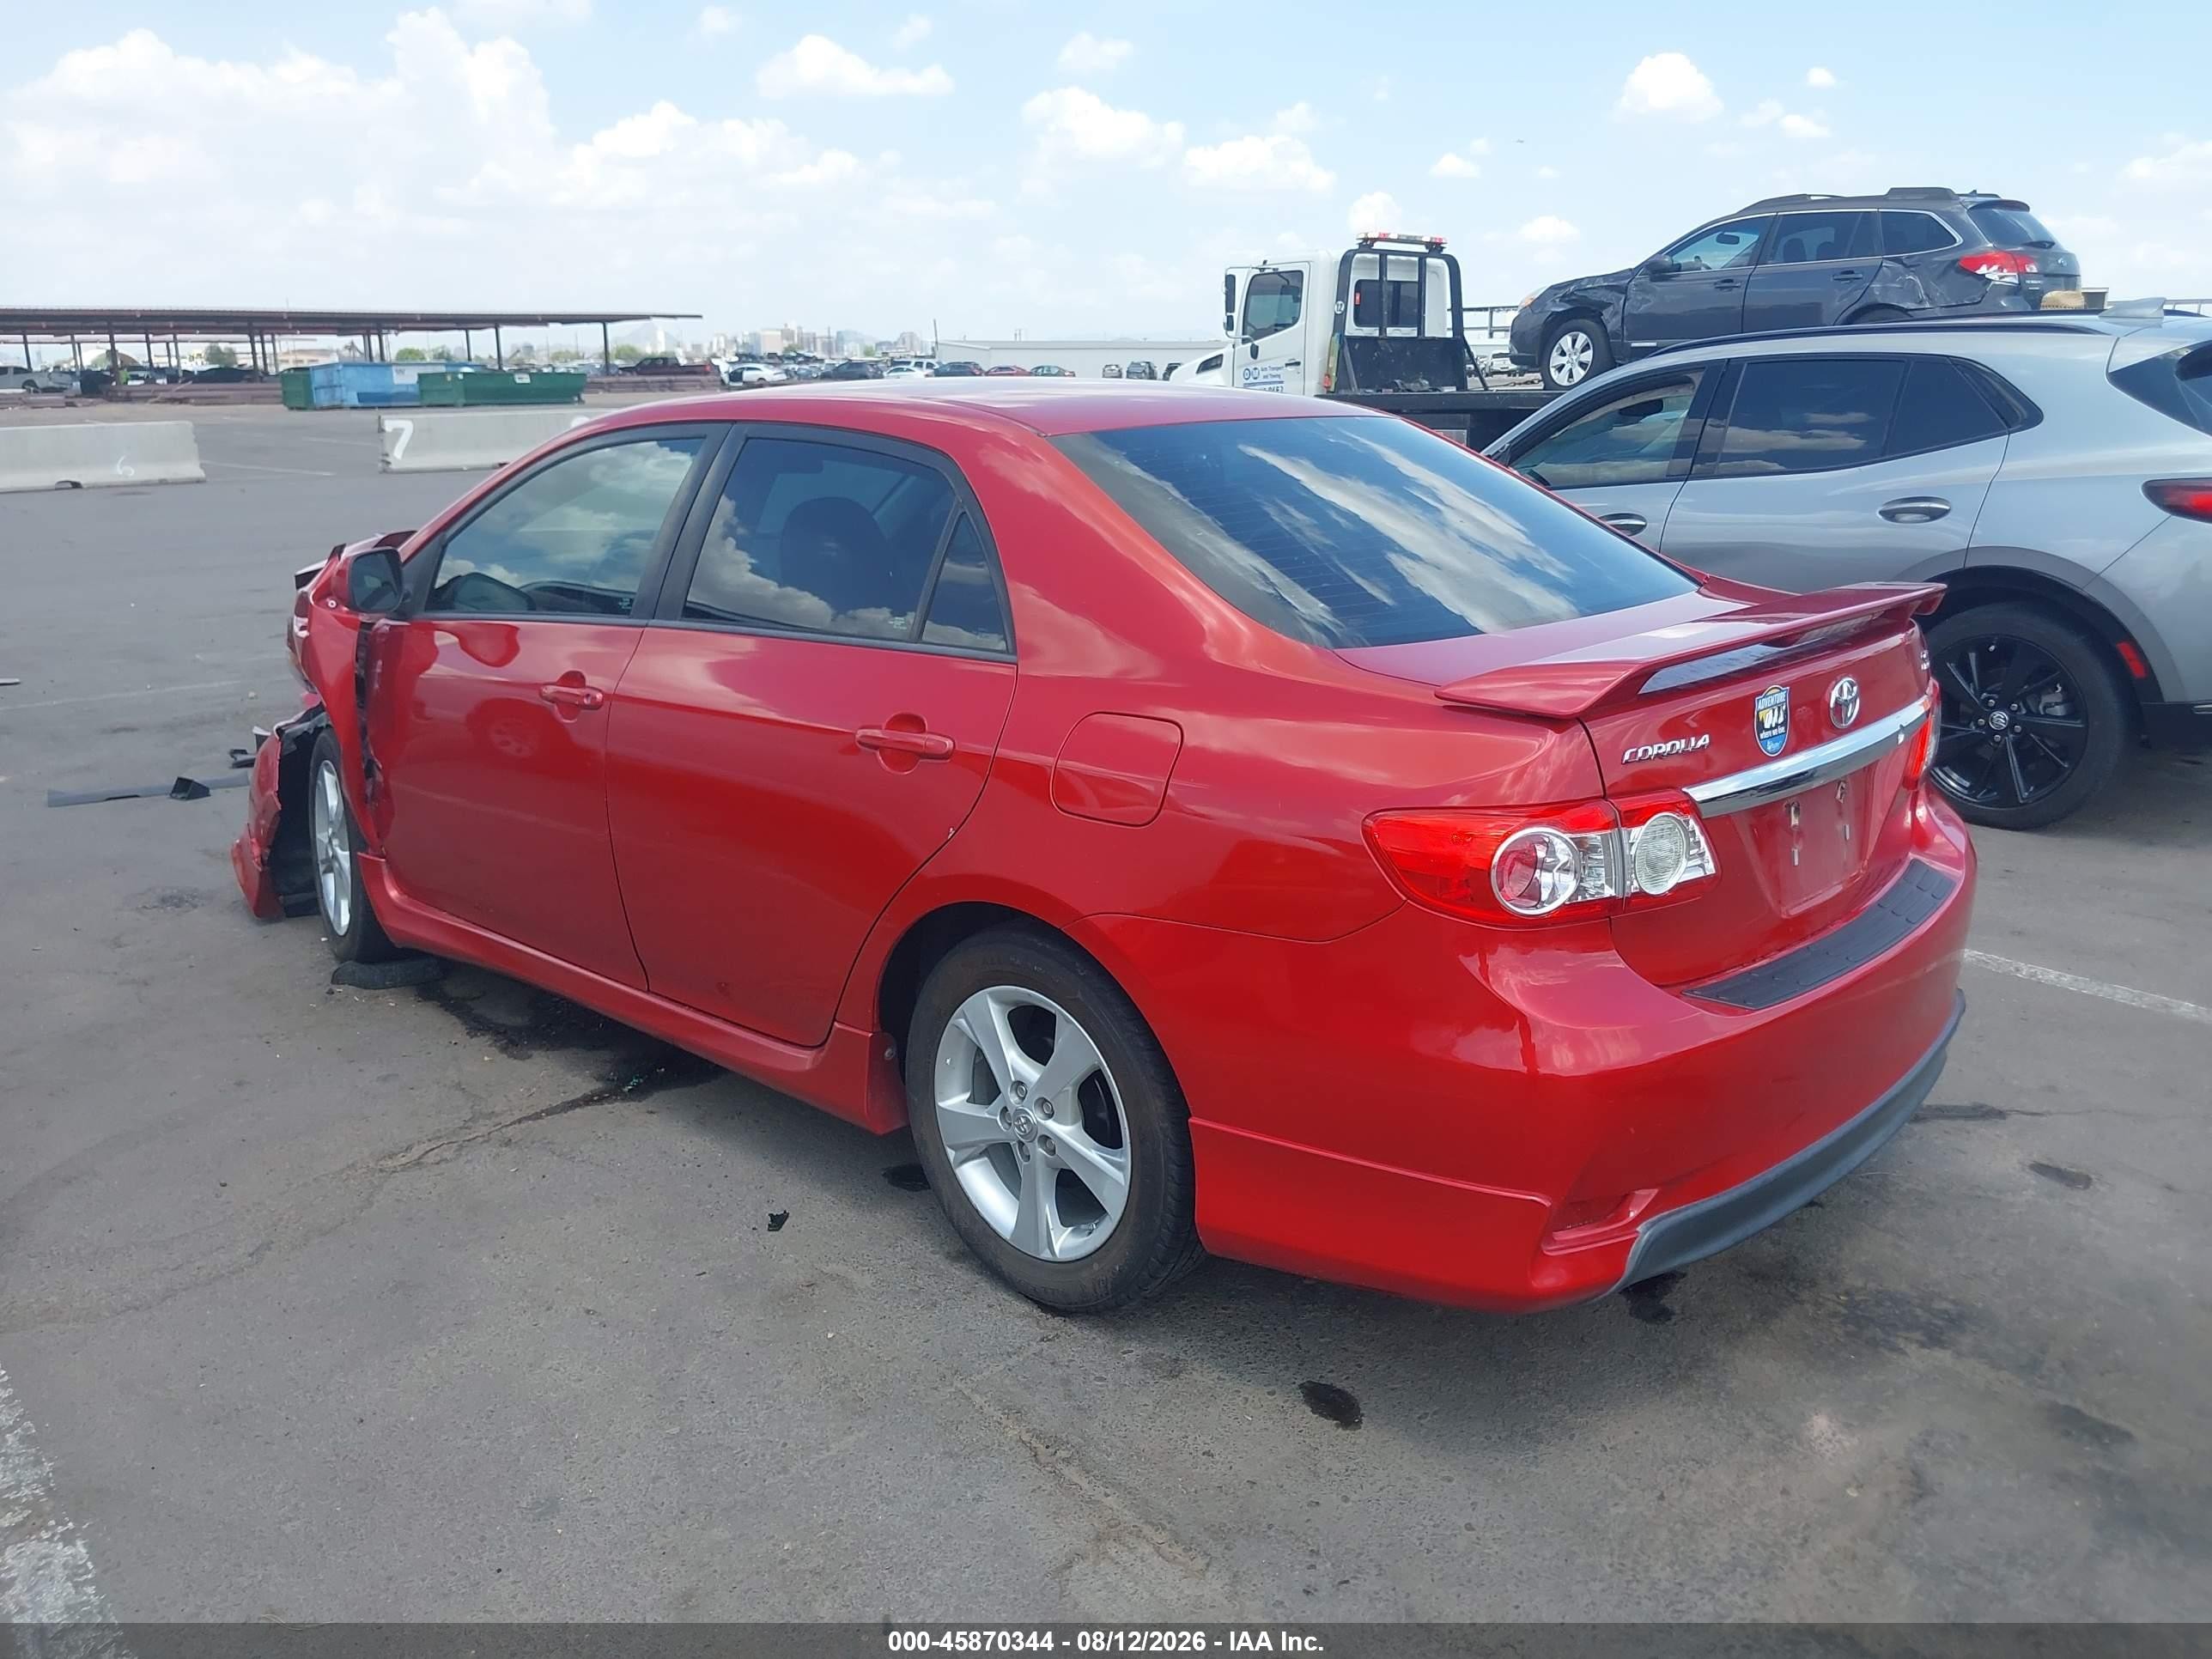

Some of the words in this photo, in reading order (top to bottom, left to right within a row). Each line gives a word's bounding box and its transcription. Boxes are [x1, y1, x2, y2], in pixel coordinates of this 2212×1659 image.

[384, 419, 414, 461] 7
[116, 454, 136, 477] 6
[1757, 691, 1787, 711] ADVENTURE
[1621, 733, 1710, 765] COROLLA
